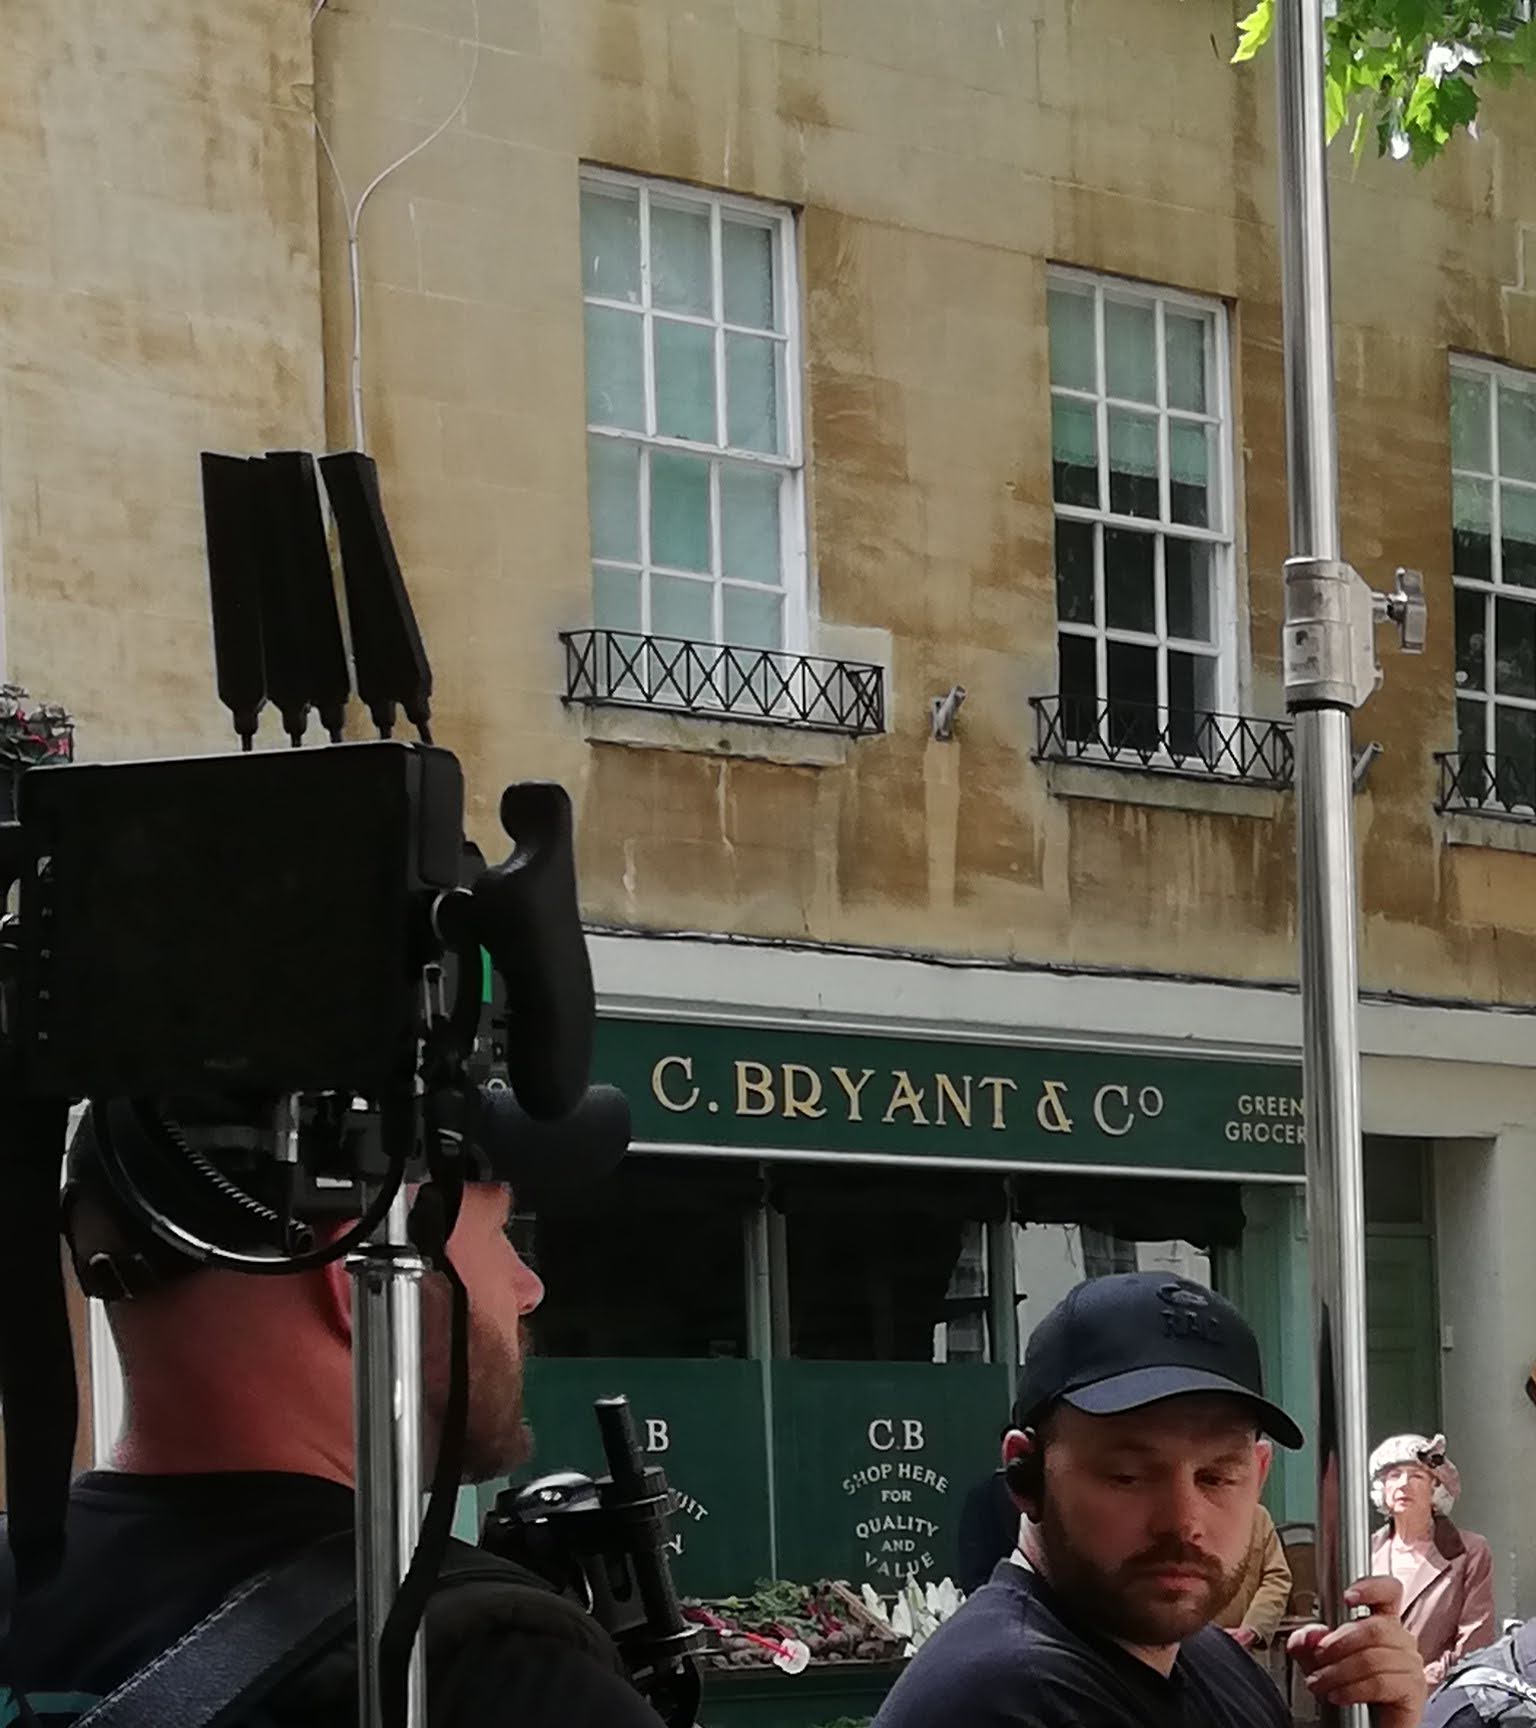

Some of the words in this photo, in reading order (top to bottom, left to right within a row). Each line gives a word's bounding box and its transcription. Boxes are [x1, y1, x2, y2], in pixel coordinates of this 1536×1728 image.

[1037, 1080, 1073, 1133] &
[1238, 1095, 1304, 1117] GREEN
[842, 1463, 892, 1495] SHOP
[898, 1463, 949, 1494] HERE
[880, 1490, 912, 1502] FOR
[855, 1515, 940, 1539] QUALITY
[881, 1540, 916, 1552] AND
[863, 1551, 935, 1578] VALUE
